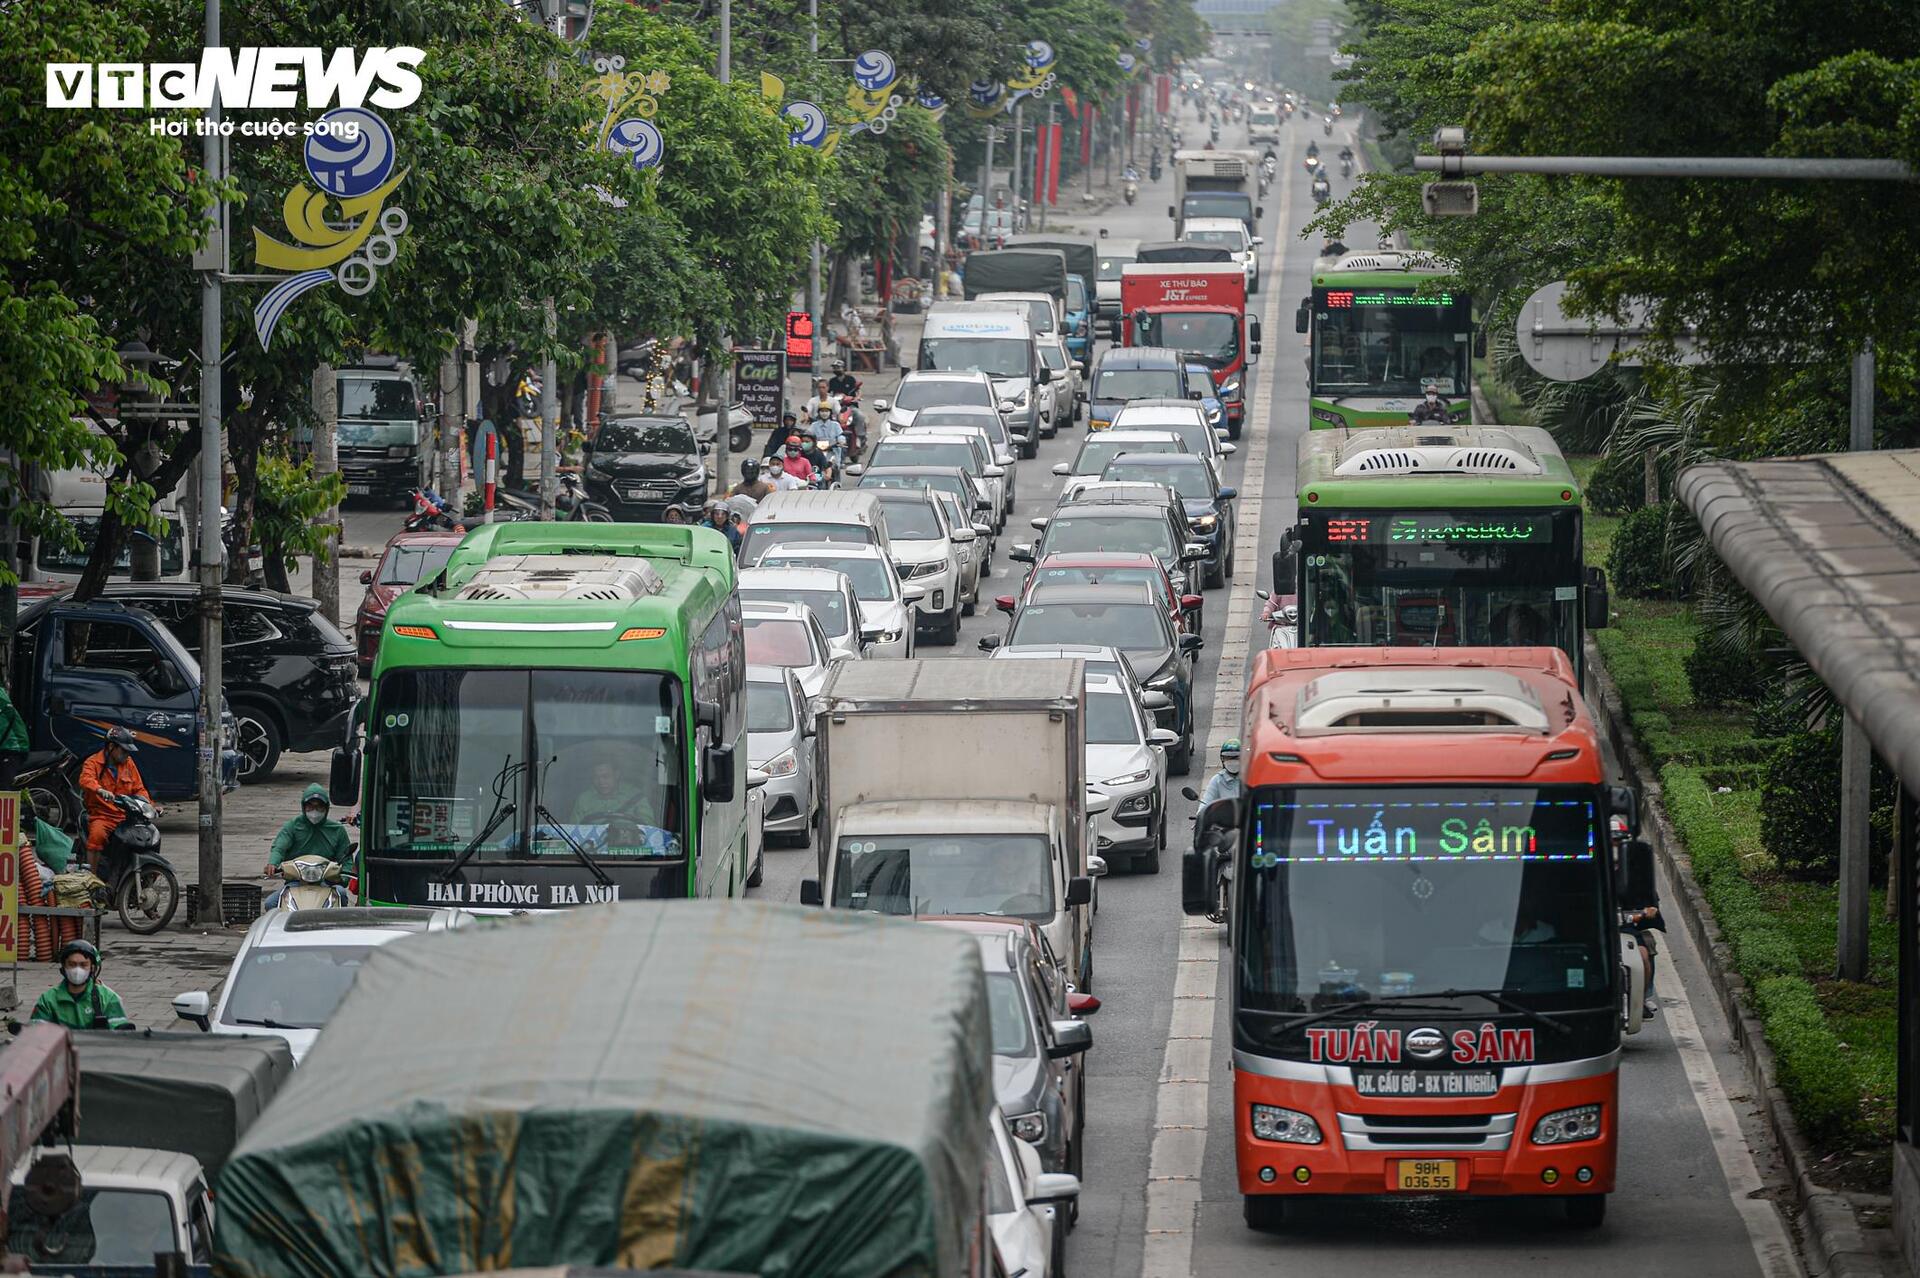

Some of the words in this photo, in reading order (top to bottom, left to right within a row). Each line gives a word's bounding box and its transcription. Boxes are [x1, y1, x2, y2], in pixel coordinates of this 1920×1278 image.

[1160, 280, 1171, 288] XE
[1160, 289, 1190, 301] J&T
[741, 363, 778, 381] Café
[1308, 810, 1417, 855] Tuấn
[1439, 818, 1536, 854] Sâm
[469, 879, 540, 904] PHÒNG
[1306, 1020, 1401, 1063] TUẤN
[1452, 1022, 1534, 1063] SÂM
[1358, 1075, 1376, 1093] BX.
[1425, 1075, 1441, 1093] BX
[1415, 1162, 1440, 1175] 98H
[1404, 1176, 1450, 1188] 036.55
